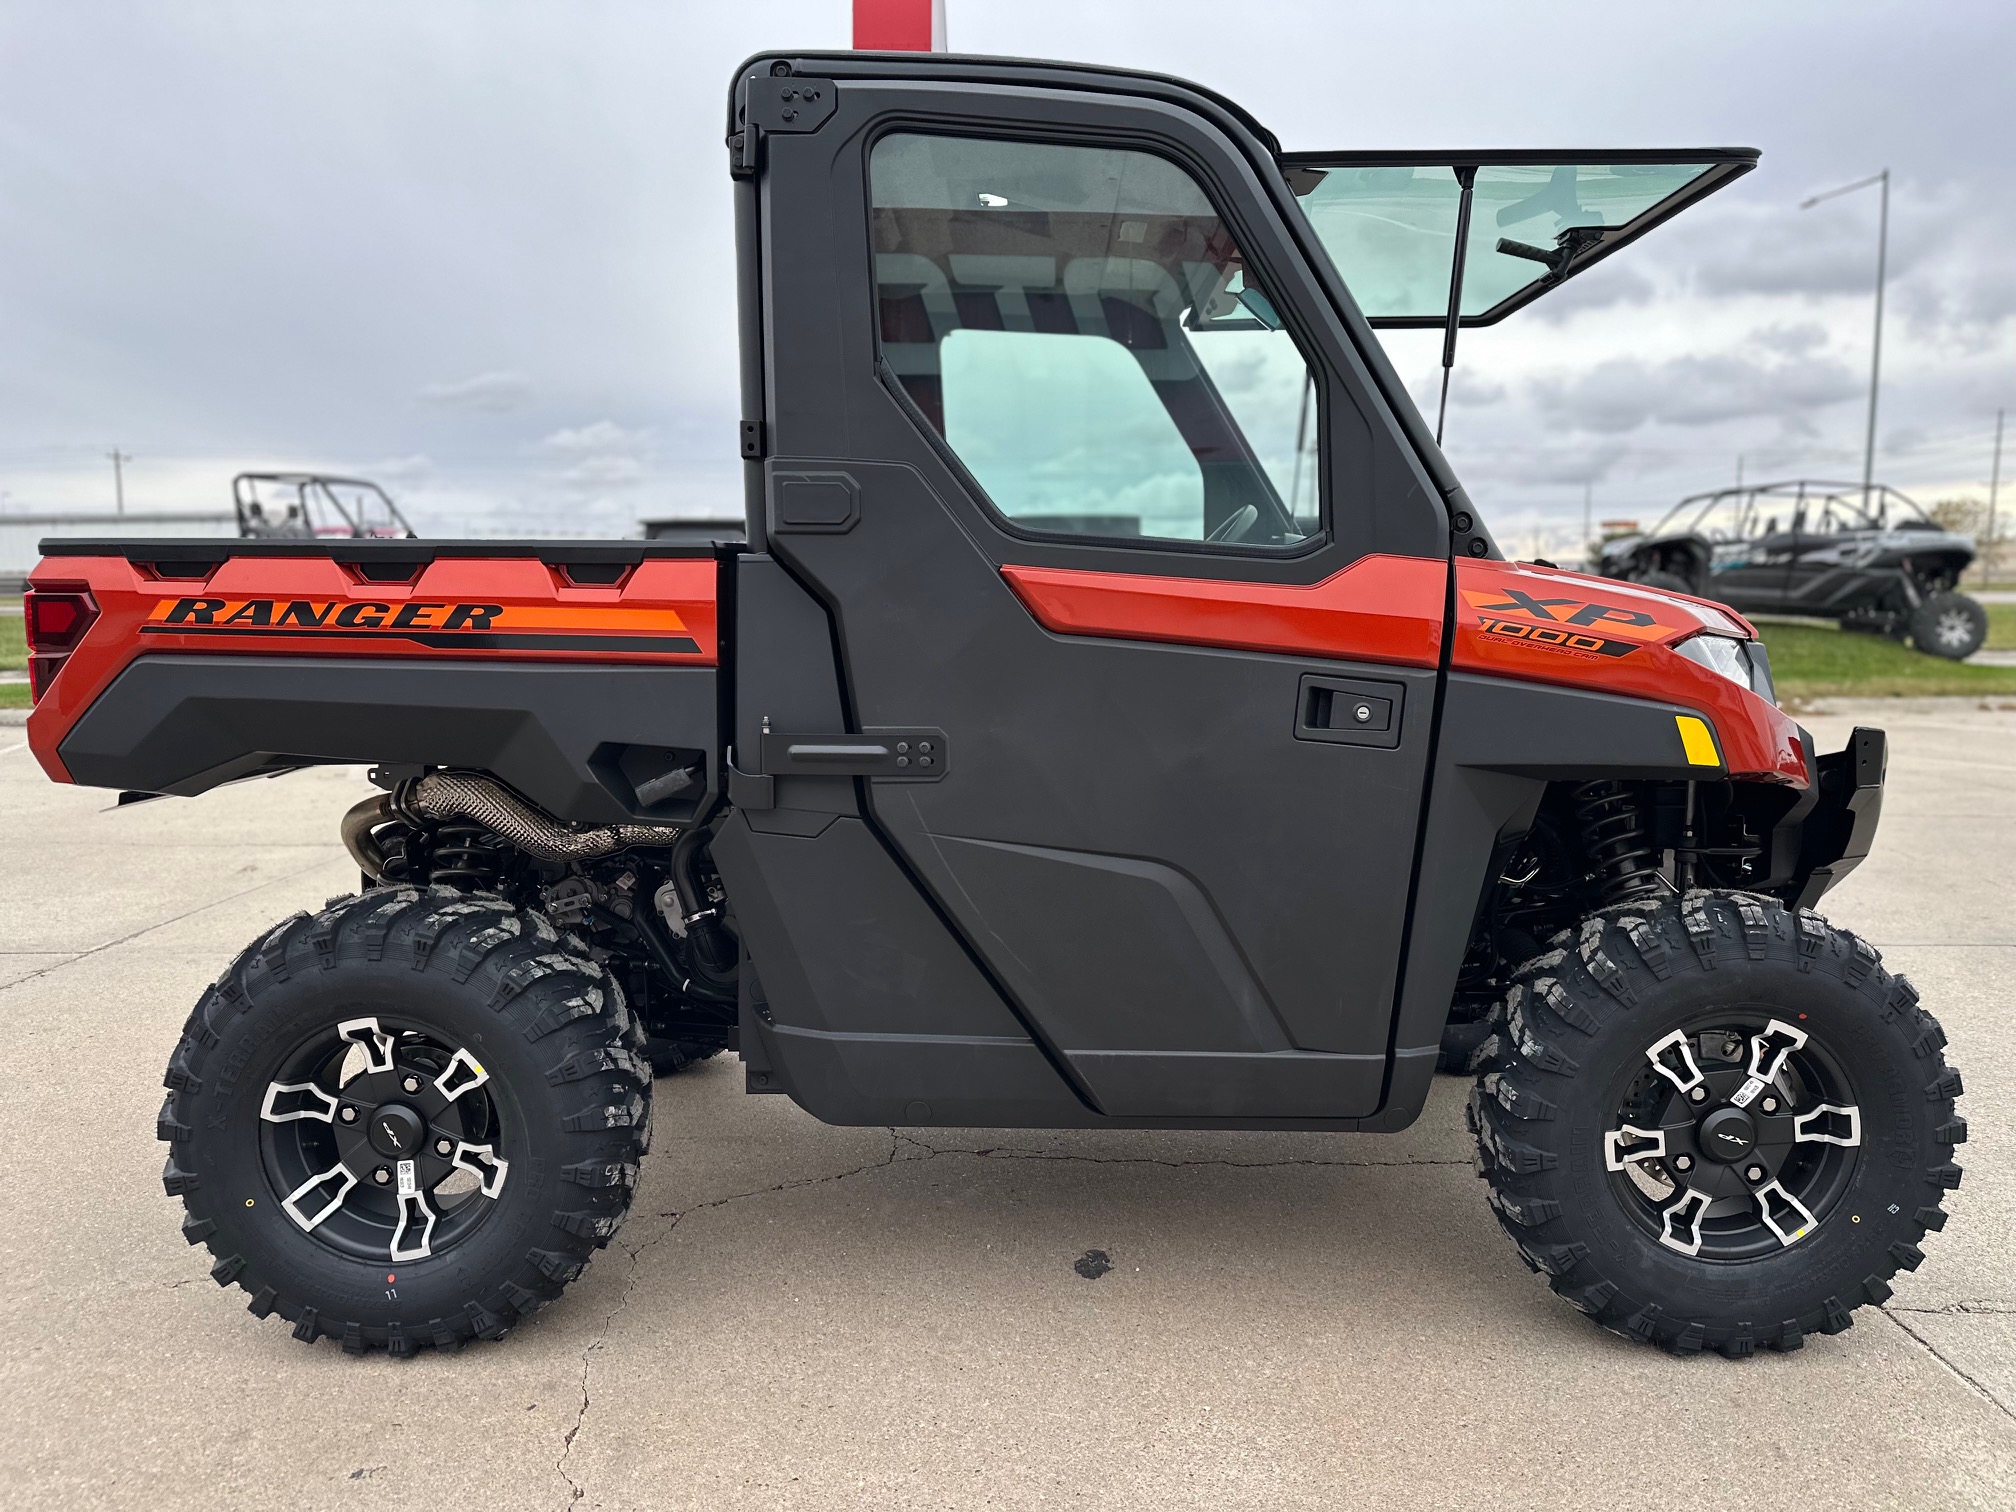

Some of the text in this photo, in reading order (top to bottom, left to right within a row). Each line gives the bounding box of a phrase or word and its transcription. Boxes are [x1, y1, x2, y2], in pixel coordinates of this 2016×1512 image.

[163, 597, 504, 630] RANGER
[1473, 588, 1656, 627] XP
[1477, 633, 1599, 660] DUAL OVERHEAD CAM
[1478, 618, 1604, 651] 1000
